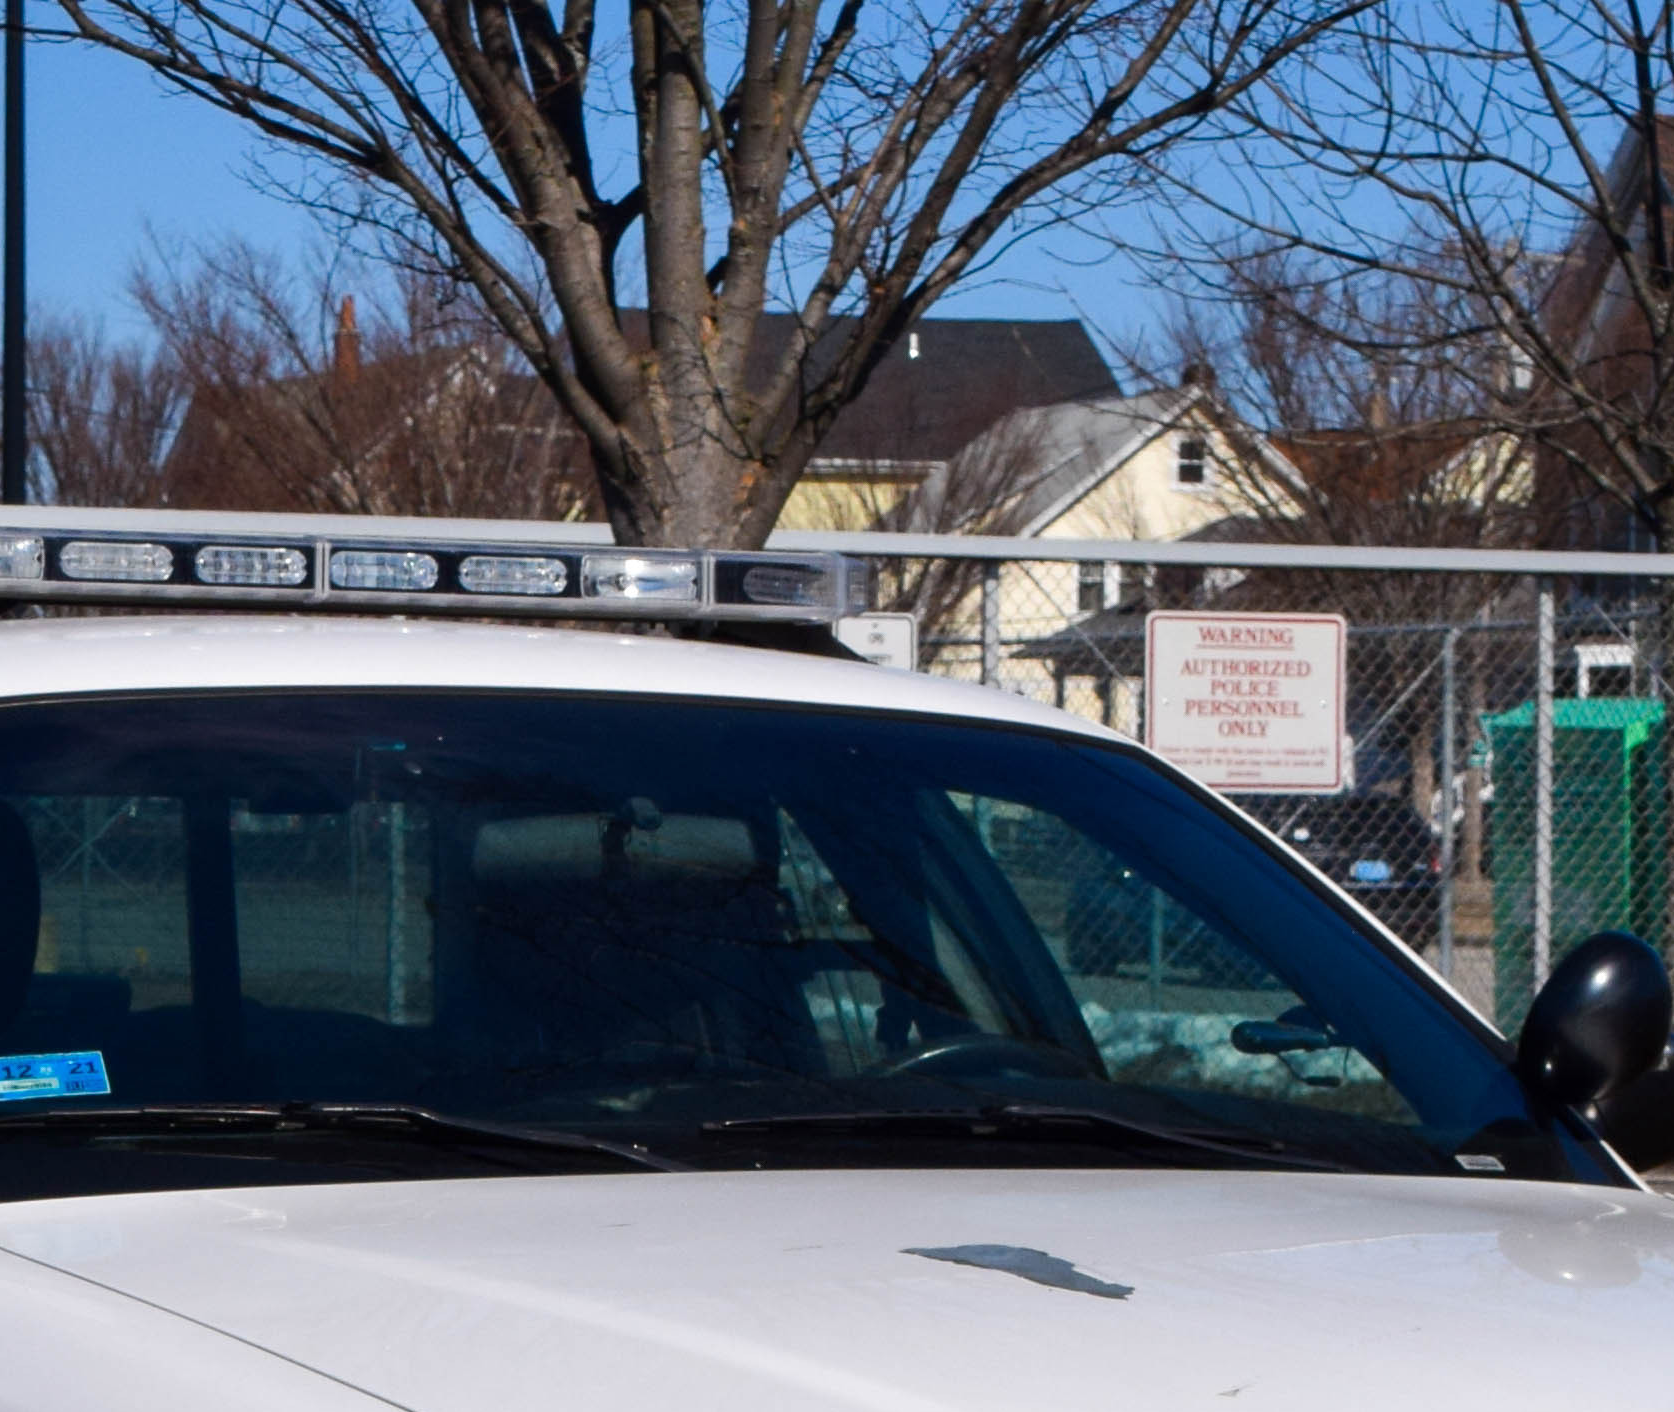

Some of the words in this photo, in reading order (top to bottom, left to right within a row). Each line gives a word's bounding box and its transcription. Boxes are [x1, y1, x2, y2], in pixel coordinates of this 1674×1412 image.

[1198, 626, 1294, 645] WARNING
[1181, 660, 1311, 678] AUTHORIZED
[1211, 680, 1279, 697] POLICE
[1185, 700, 1303, 718] PERSONNEL
[1218, 720, 1269, 738] ONLY
[2, 1064, 34, 1080] 12
[70, 1061, 99, 1075] 21
